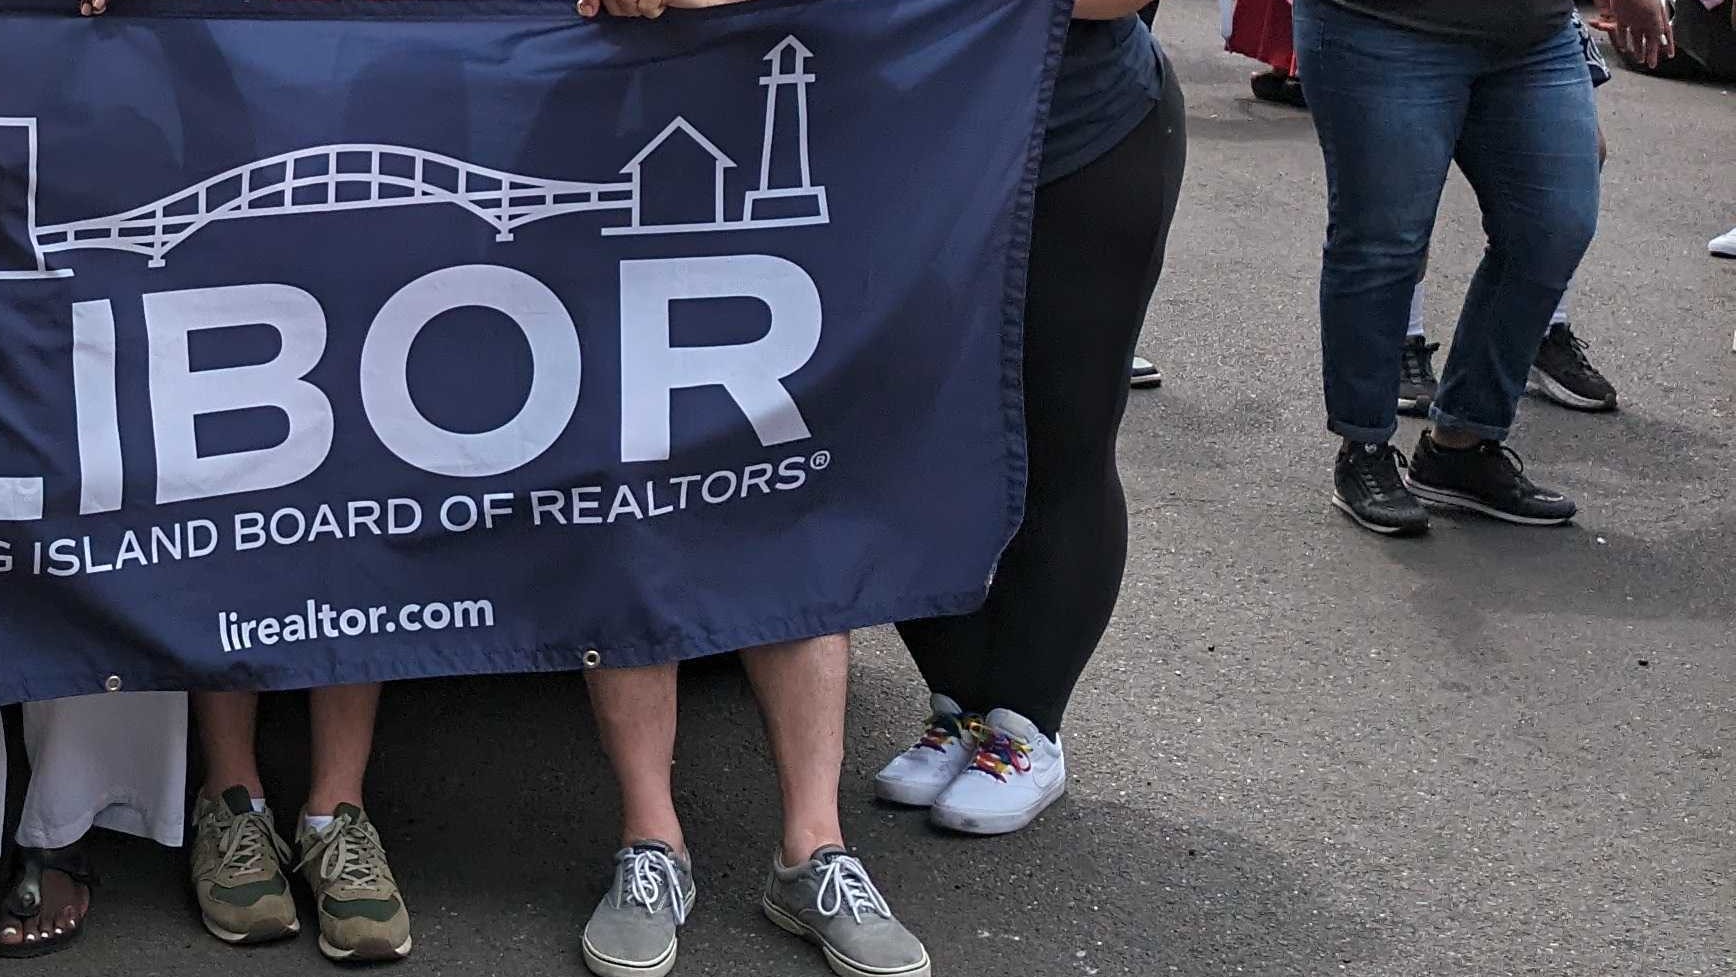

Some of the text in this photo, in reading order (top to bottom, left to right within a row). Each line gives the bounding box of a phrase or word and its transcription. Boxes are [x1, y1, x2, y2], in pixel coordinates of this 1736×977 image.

[32, 518, 219, 577] ISLAND
[234, 496, 423, 552] BOARD
[439, 492, 515, 531] OF
[218, 598, 495, 652] lirealtor.com
